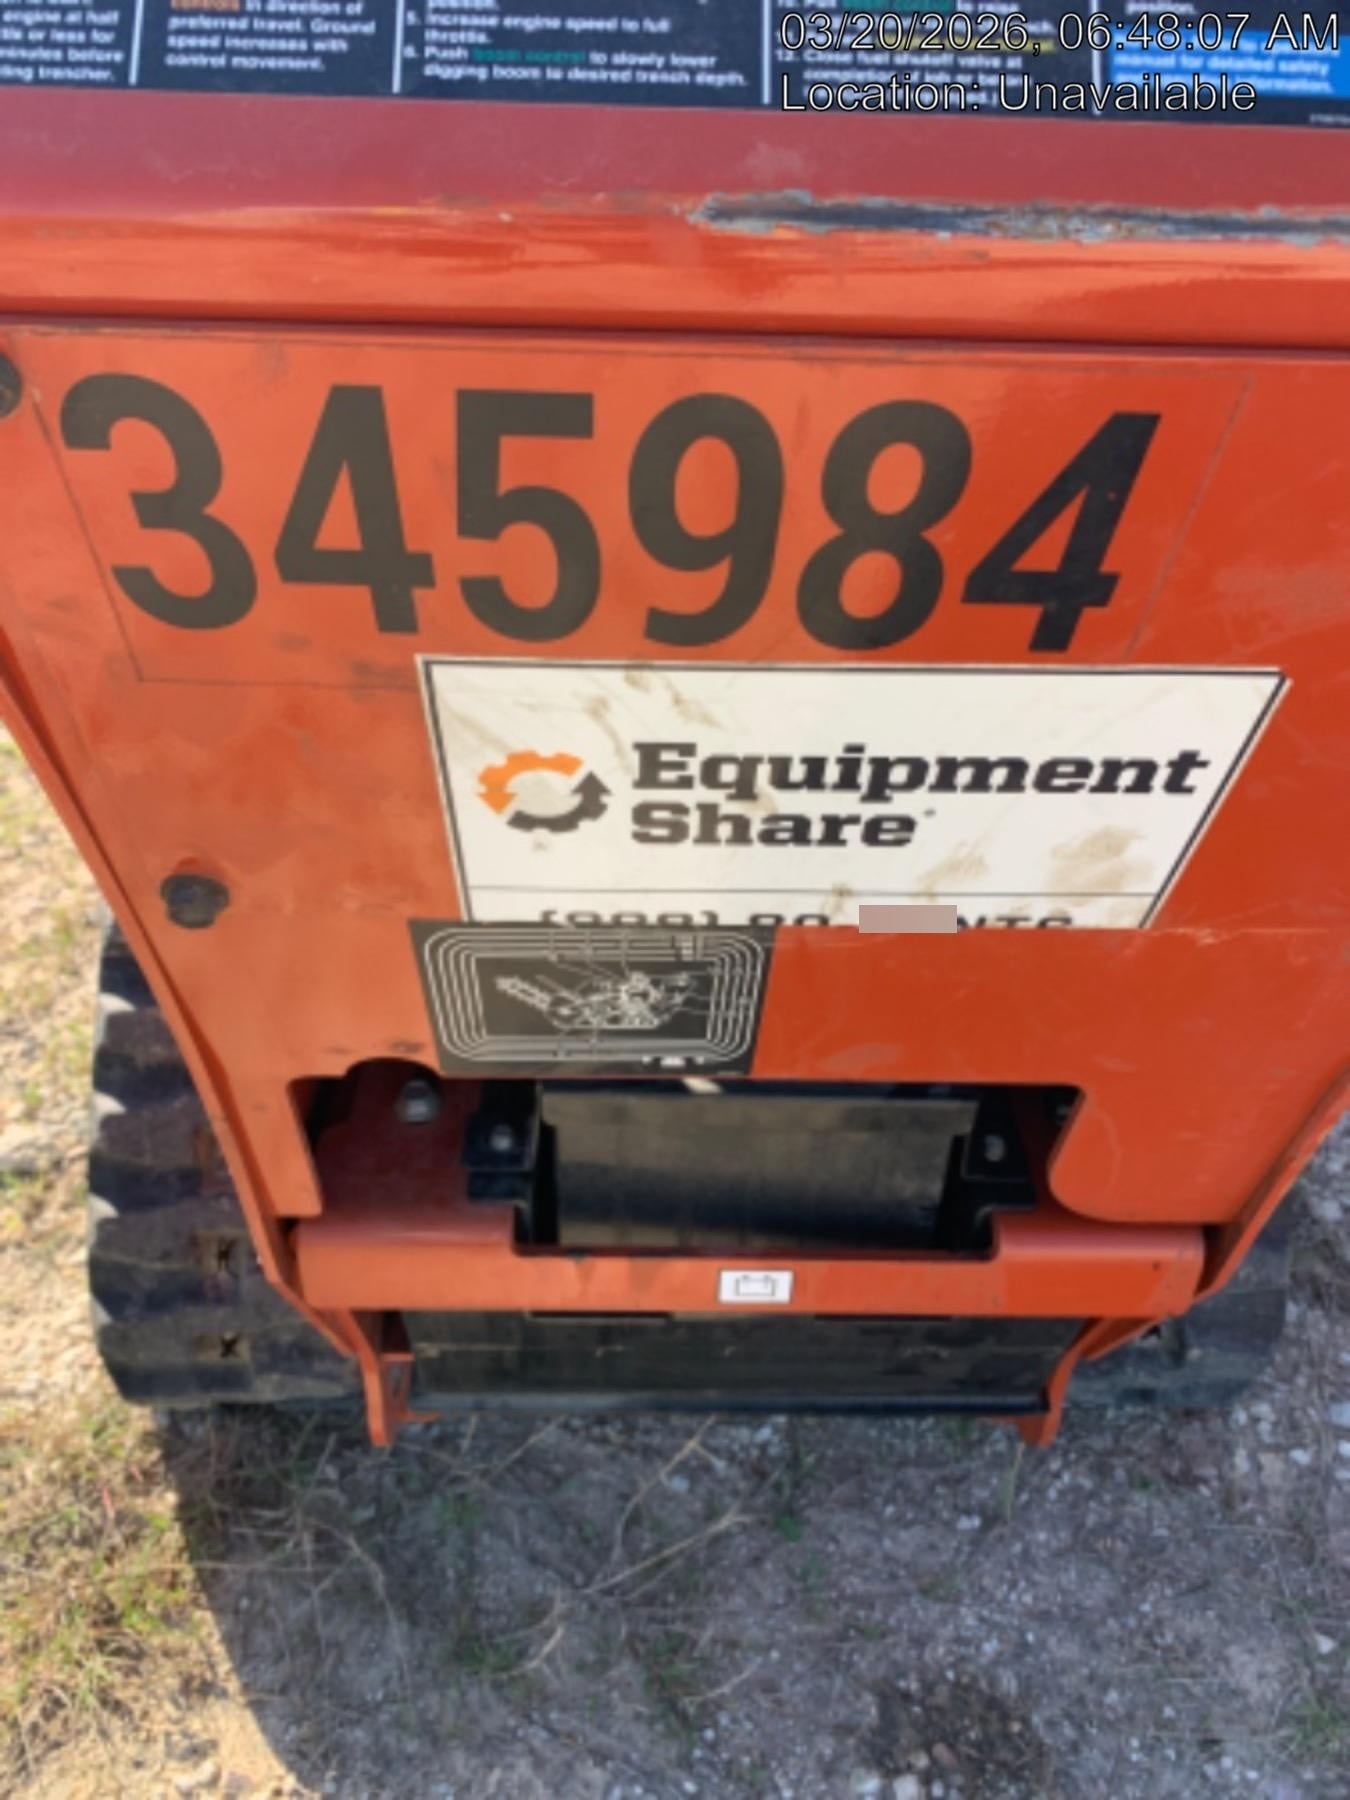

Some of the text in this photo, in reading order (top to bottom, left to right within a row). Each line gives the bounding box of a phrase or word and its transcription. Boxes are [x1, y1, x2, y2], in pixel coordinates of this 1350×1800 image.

[346, 0, 363, 15] of
[3, 10, 119, 26] engine at half
[168, 16, 377, 34] preferred travel. Ground
[426, 12, 499, 27] Increase
[503, 15, 561, 33] engine
[565, 16, 618, 33] speed
[621, 17, 640, 33] to
[643, 17, 671, 33] full
[28, 30, 45, 42] or
[50, 28, 86, 43] less
[91, 28, 115, 43] for
[167, 34, 348, 53] speed increases with
[67, 46, 123, 63] before
[165, 52, 326, 71] control movement.
[424, 45, 468, 60] Push
[589, 51, 608, 65] to
[611, 51, 665, 69] slowly
[670, 52, 718, 67] lower
[803, 50, 854, 64] Close
[39, 65, 115, 82] trencher.
[1114, 53, 1176, 68] manual
[1206, 55, 1275, 72] detailed
[1279, 58, 1330, 76] safety
[424, 63, 489, 82] digging
[492, 64, 542, 80] boom
[546, 66, 564, 80] to
[568, 66, 632, 82] desired
[695, 70, 750, 87] depth.
[60, 373, 1161, 651] 345984
[632, 741, 1209, 802] Equipment
[632, 801, 918, 847] Share
